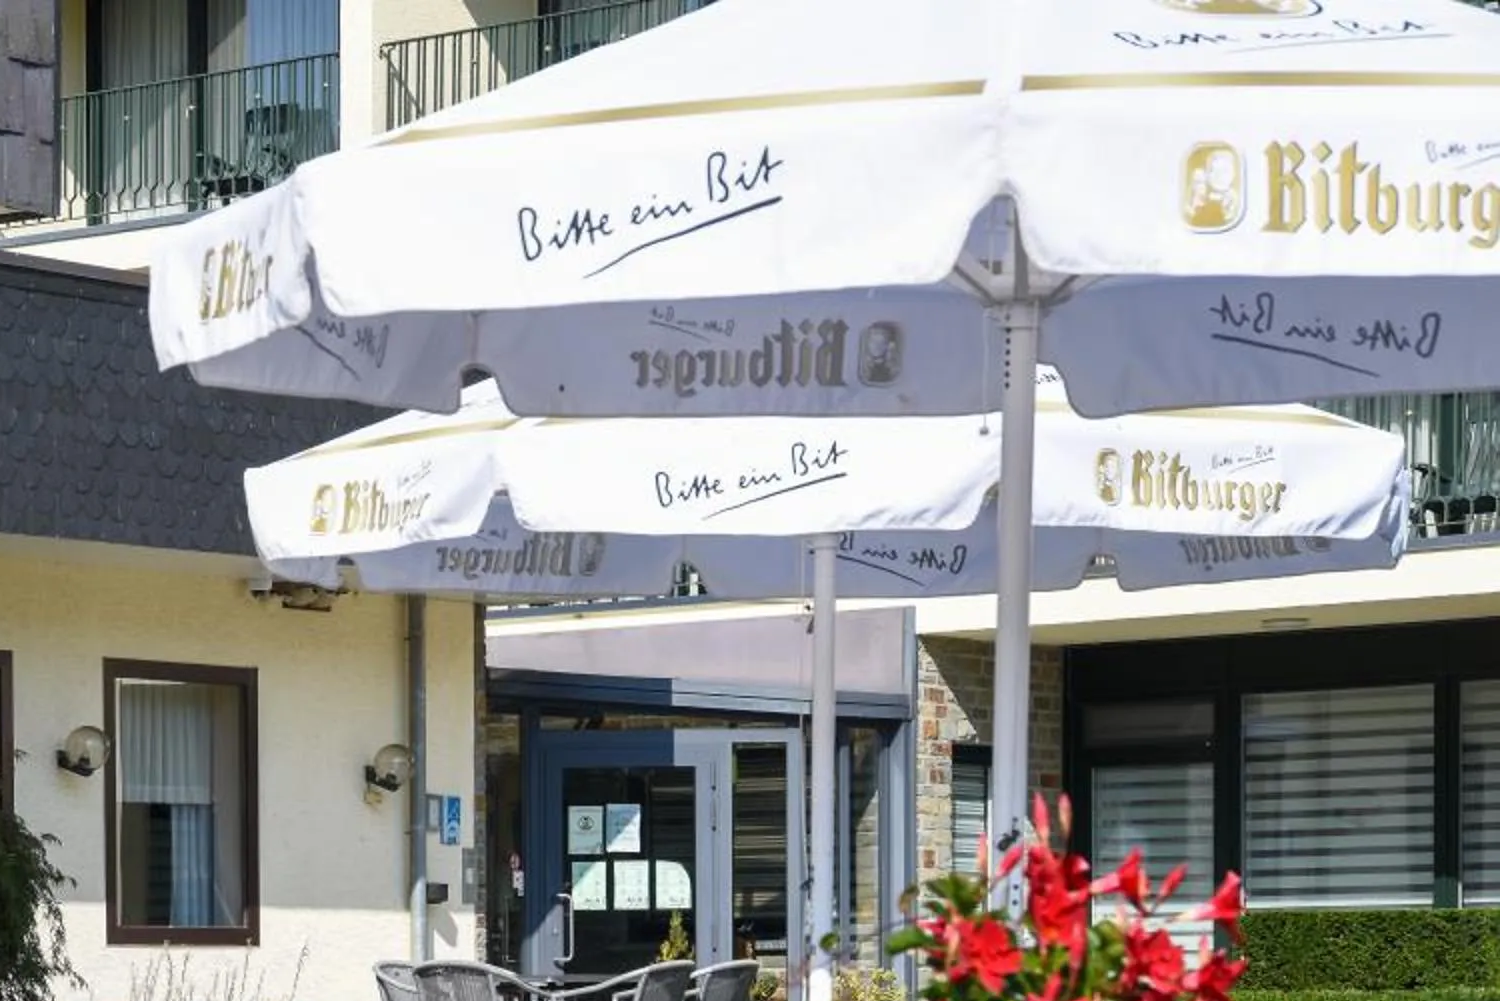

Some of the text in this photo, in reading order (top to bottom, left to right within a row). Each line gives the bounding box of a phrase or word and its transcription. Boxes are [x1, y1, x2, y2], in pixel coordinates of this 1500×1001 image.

[519, 144, 784, 261] Bitte ein Bit
[655, 440, 848, 508] Bitte ein Bit
[1131, 448, 1286, 521] Bitburger
